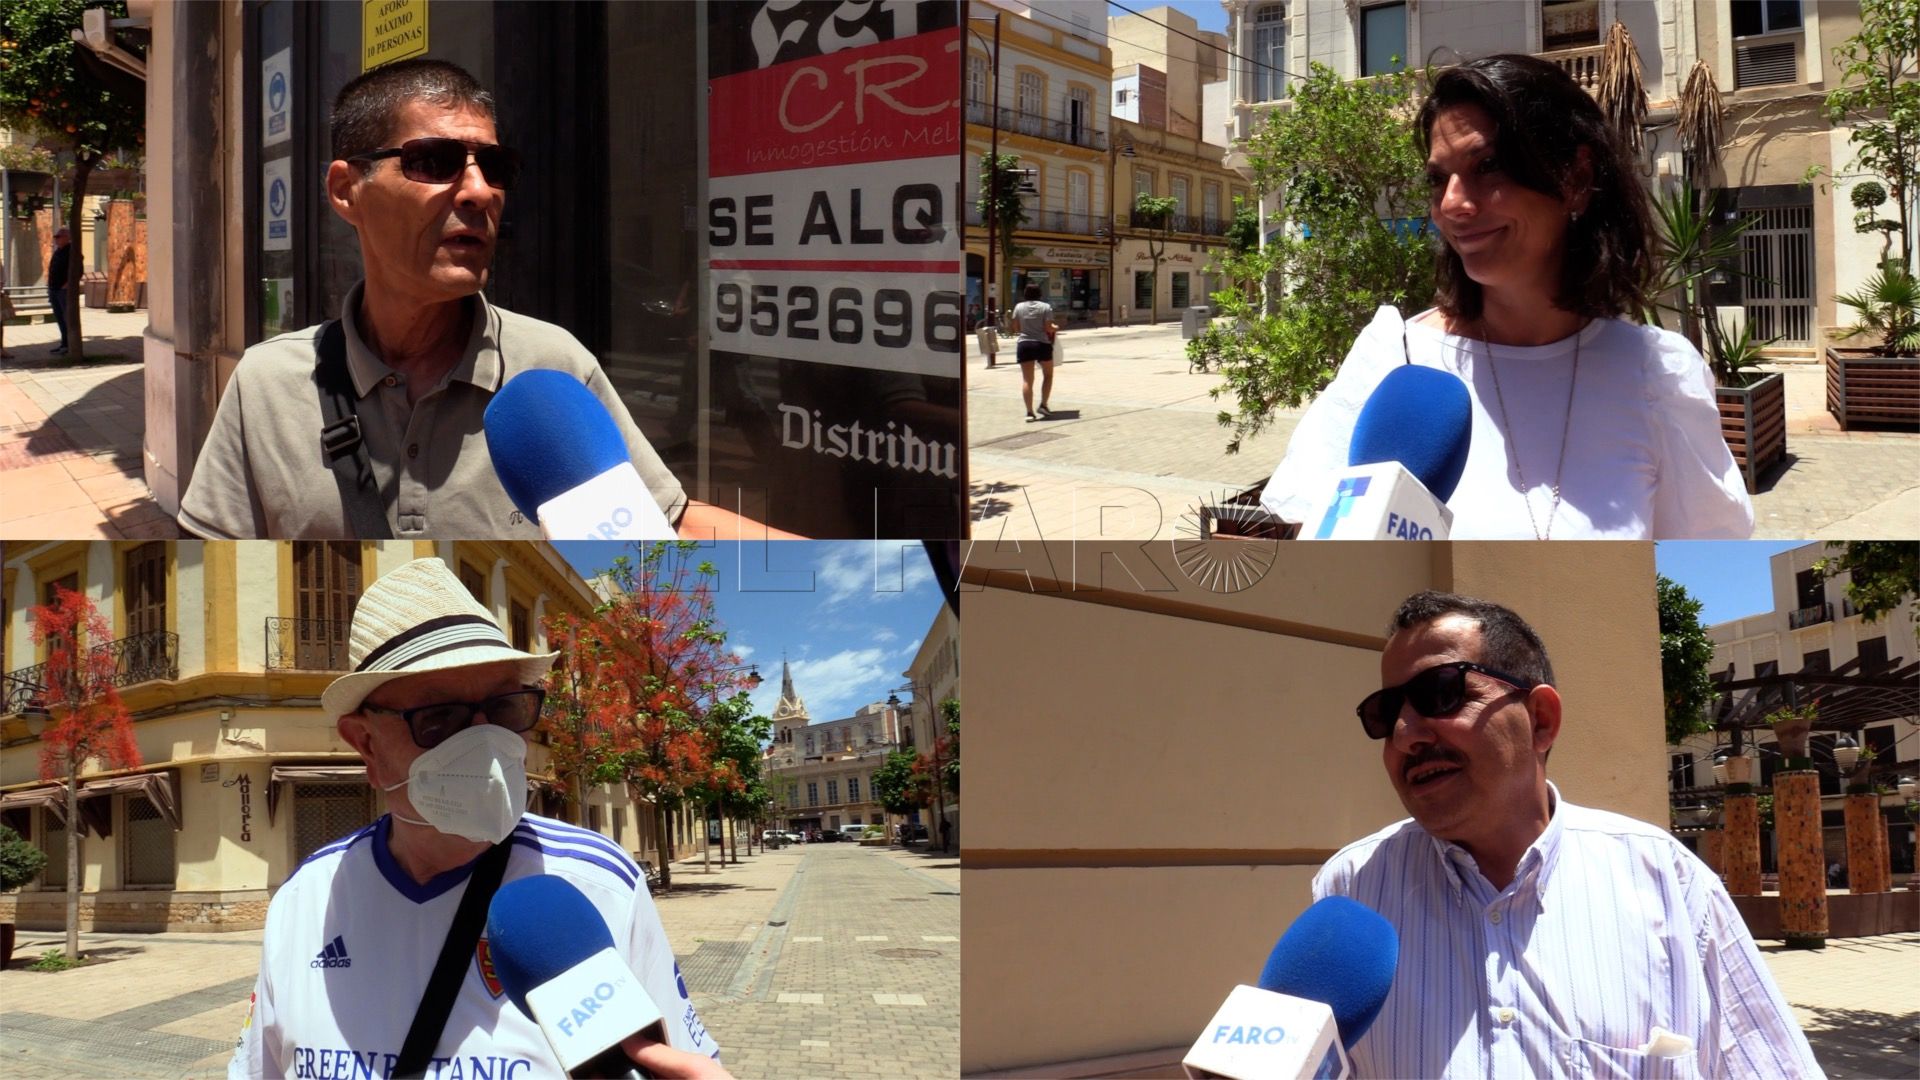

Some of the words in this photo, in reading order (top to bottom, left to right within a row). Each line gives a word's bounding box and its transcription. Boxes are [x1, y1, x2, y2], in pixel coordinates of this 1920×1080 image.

[375, 11, 413, 37] MÁXIMO
[367, 46, 375, 58] 10
[377, 25, 423, 54] PERSONAS
[746, 129, 893, 165] Inmogestión
[709, 194, 774, 247] SE
[716, 283, 960, 354] 952696
[778, 402, 959, 480] Distribu
[1387, 511, 1433, 540] FARO
[222, 773, 251, 842] Mallorca
[310, 958, 351, 969] adidas
[557, 982, 615, 1038] FARO
[1212, 1025, 1286, 1046] FARO
[294, 1047, 378, 1080] GREEN
